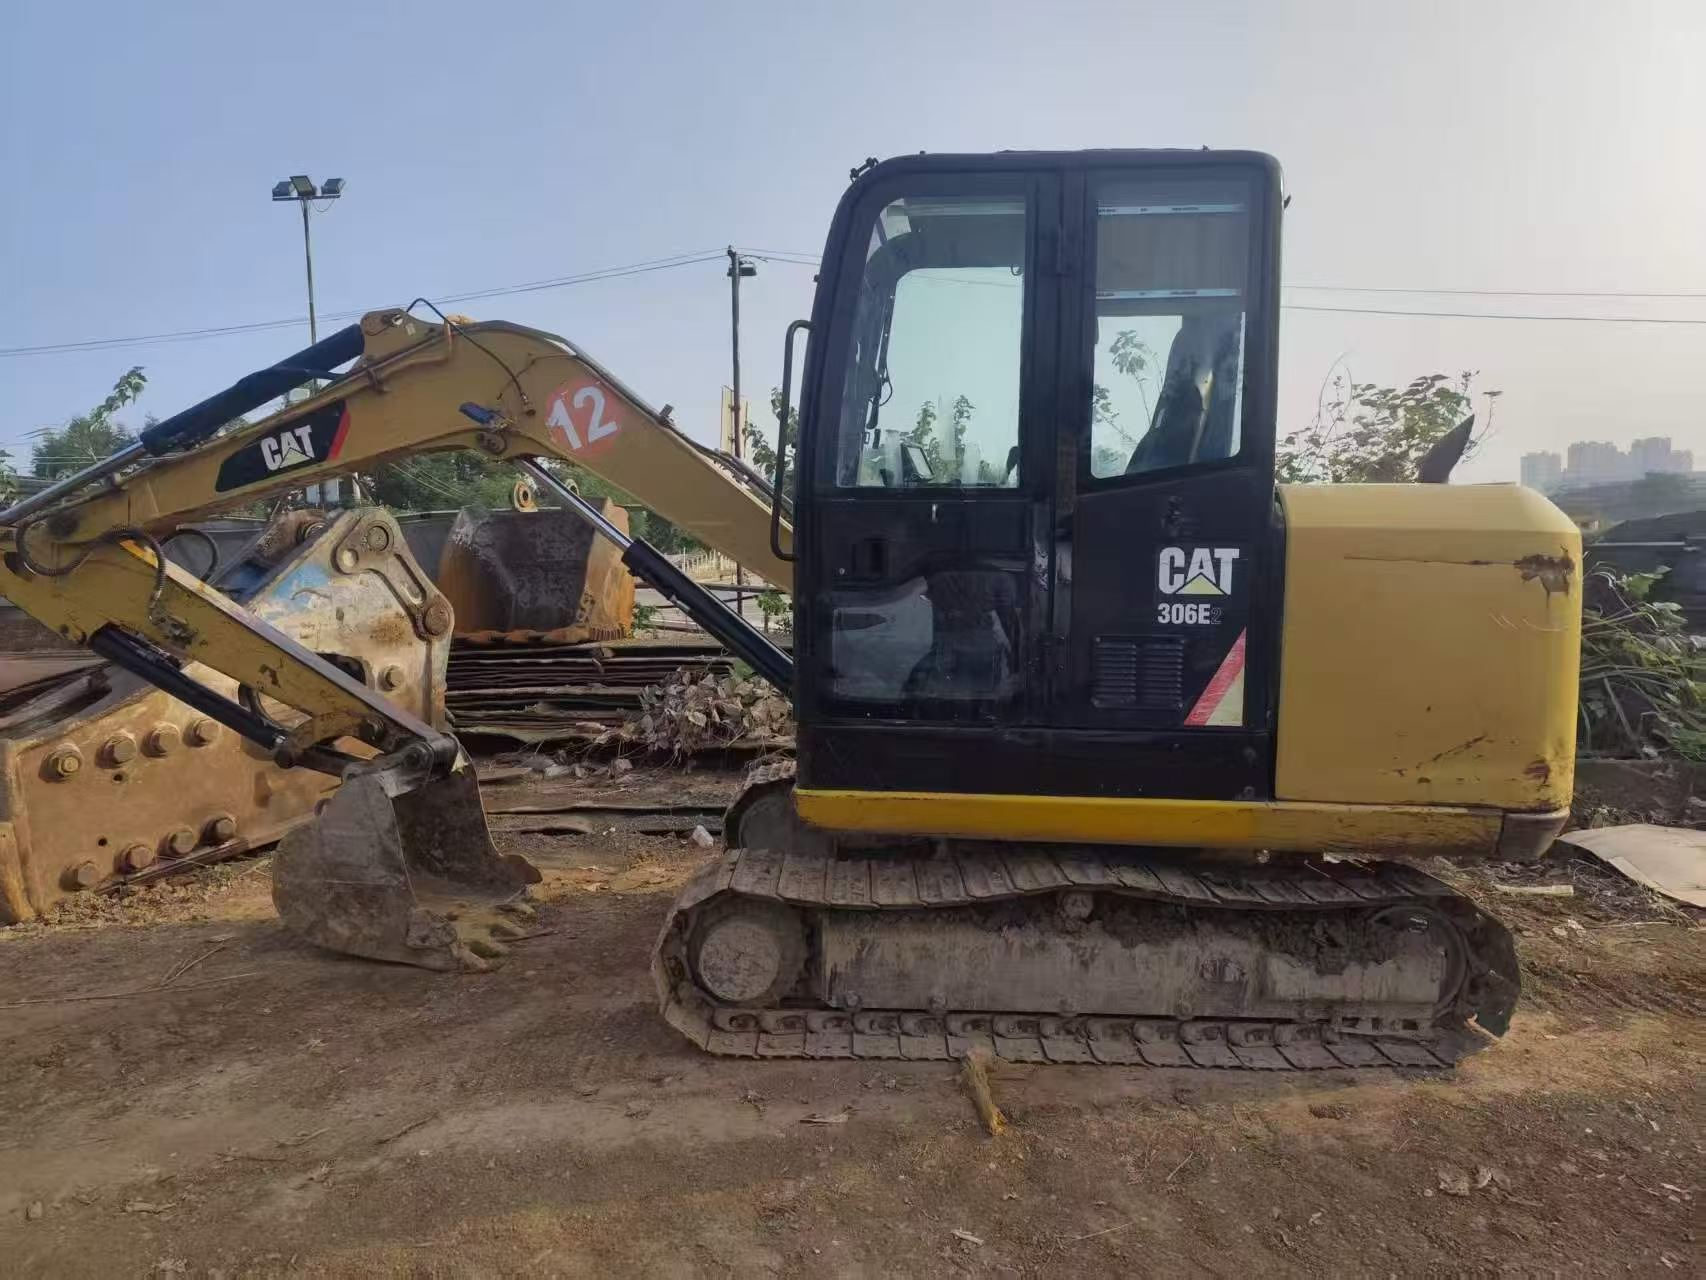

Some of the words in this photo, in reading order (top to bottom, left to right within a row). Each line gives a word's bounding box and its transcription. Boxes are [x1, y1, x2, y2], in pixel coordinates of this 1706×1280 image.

[546, 386, 617, 449] 12
[260, 424, 315, 470] CAT
[1158, 546, 1240, 595] CAT
[1157, 603, 1222, 625] 306E2
